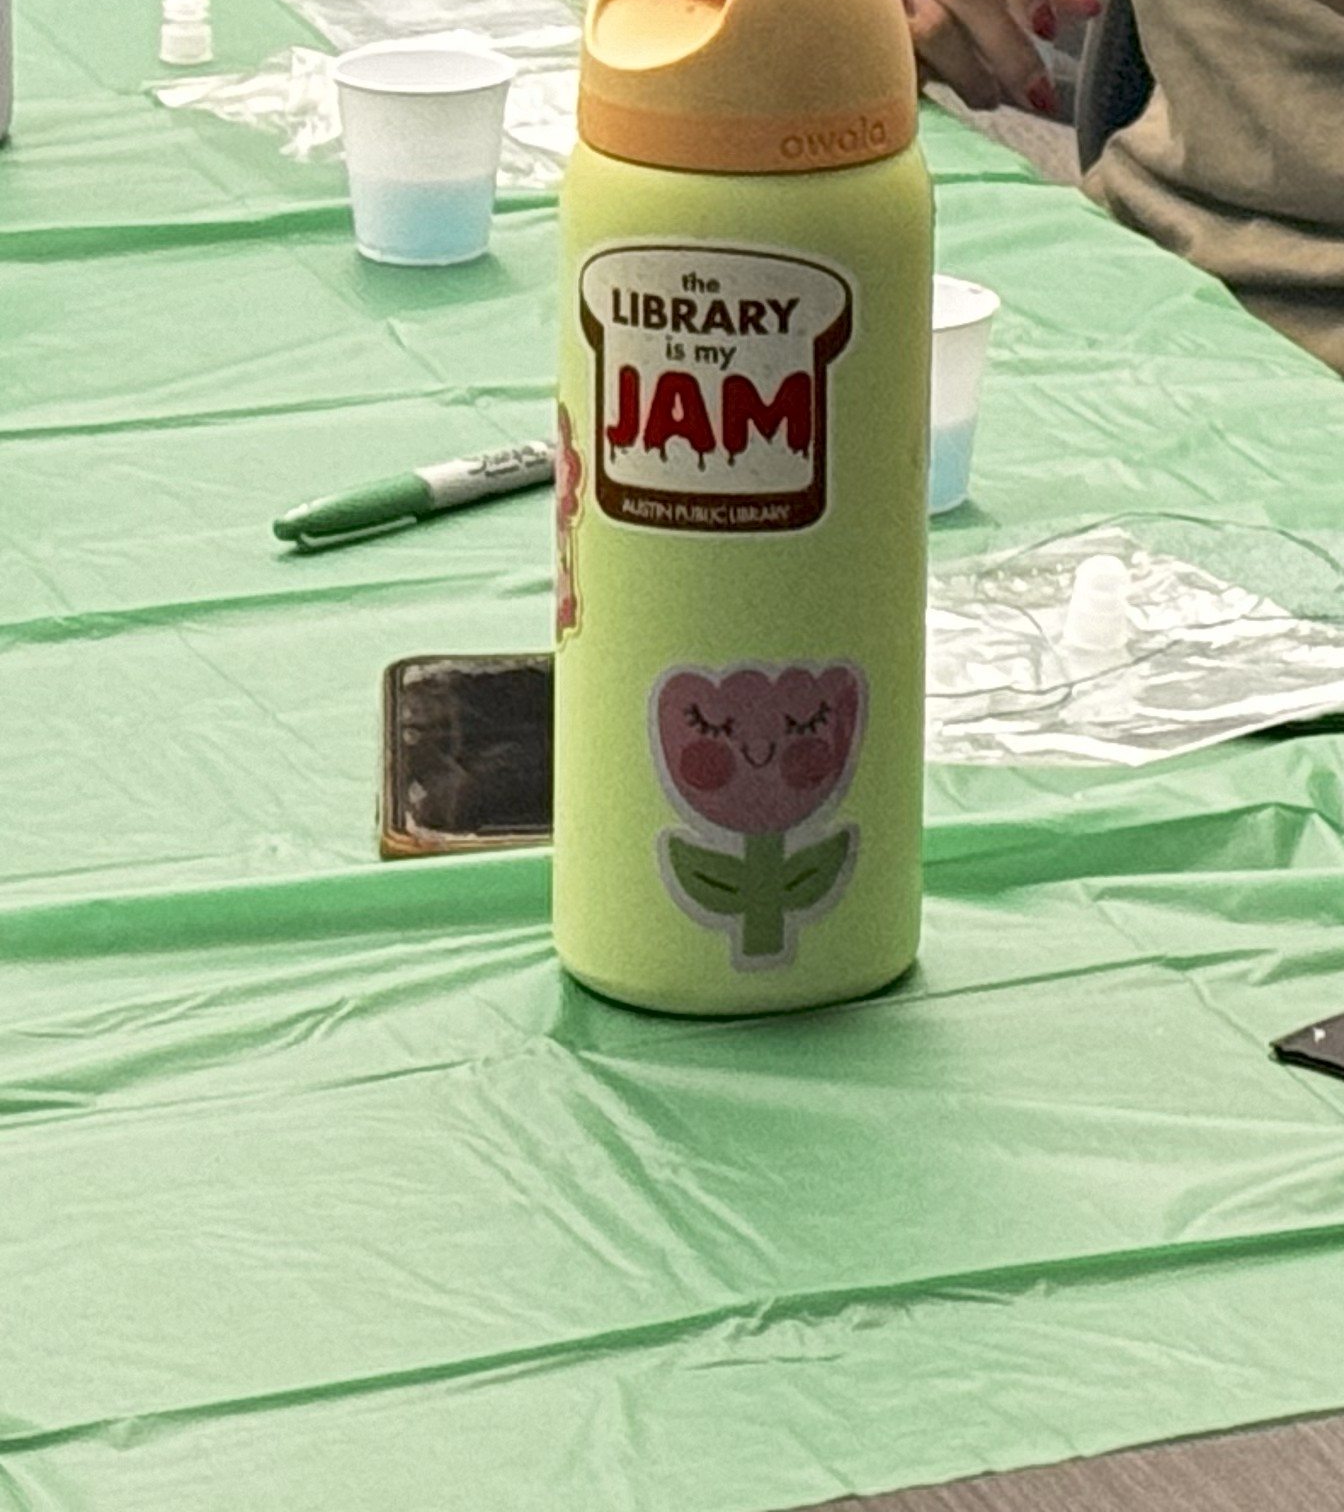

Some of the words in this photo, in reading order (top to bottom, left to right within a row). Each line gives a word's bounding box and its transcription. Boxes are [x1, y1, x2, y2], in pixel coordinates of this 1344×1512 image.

[681, 272, 721, 294] the
[611, 288, 800, 336] LIBRARY
[665, 336, 686, 360] is
[694, 344, 737, 370] my
[606, 364, 813, 468] JAM
[622, 497, 673, 520] AUSTIN
[674, 503, 727, 524] PUBLIC
[728, 503, 791, 525] LIBRARY
